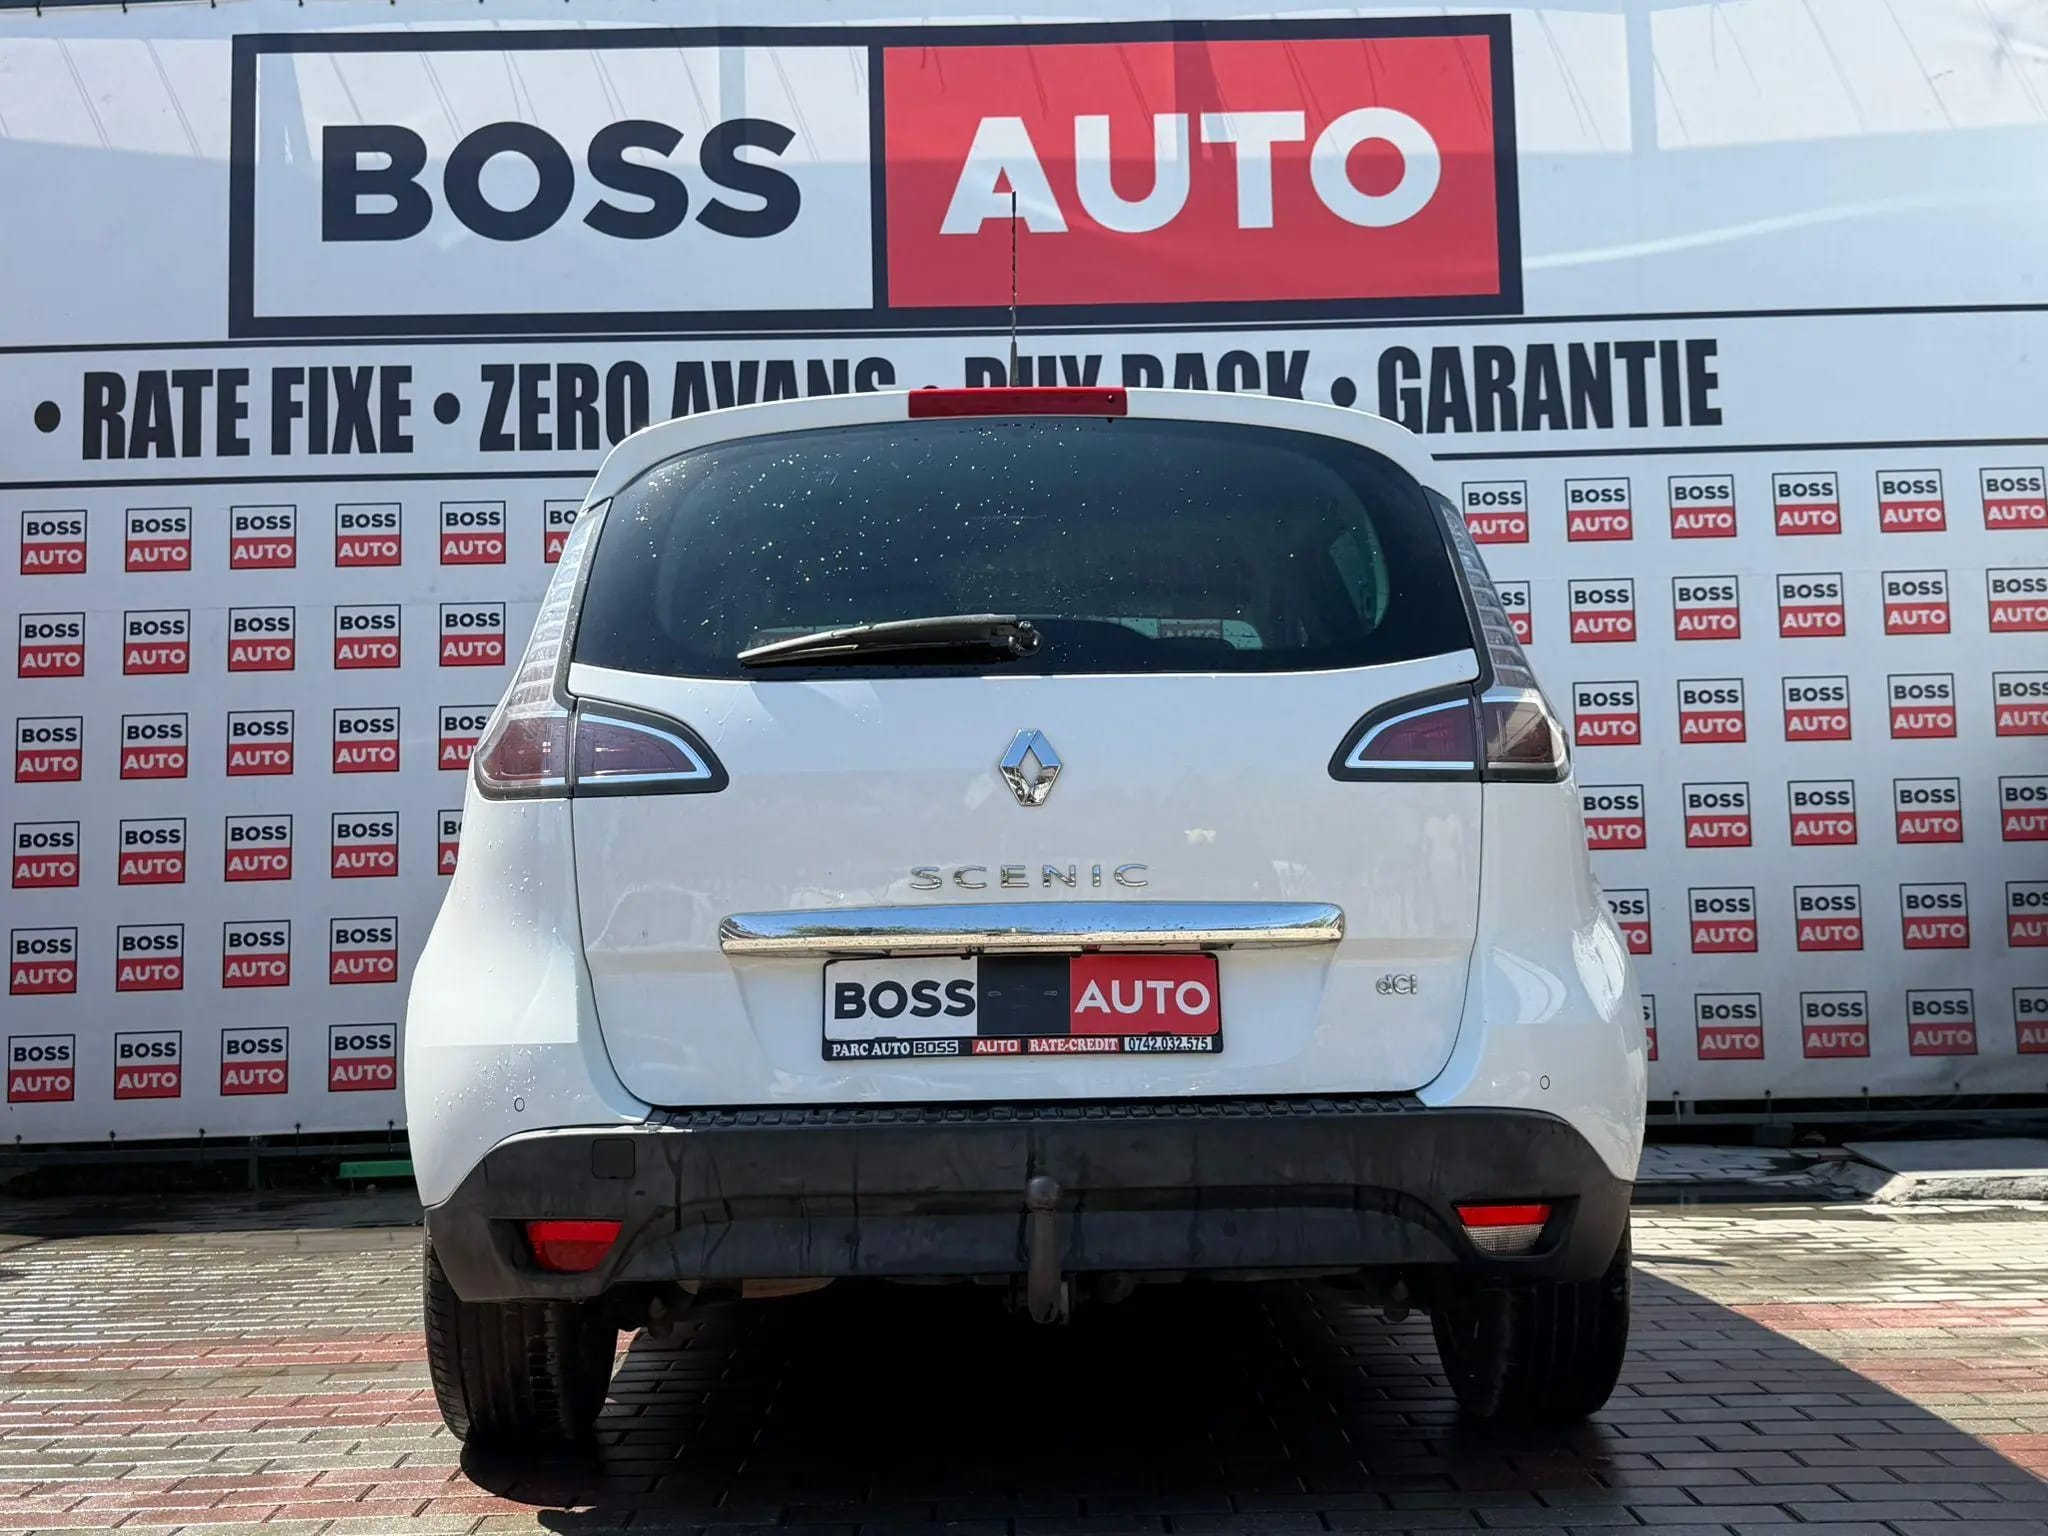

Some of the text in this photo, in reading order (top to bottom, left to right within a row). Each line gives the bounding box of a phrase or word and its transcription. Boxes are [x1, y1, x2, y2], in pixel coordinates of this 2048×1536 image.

[322, 106, 1441, 242] BOSS AUTO
[82, 368, 250, 460] RATE
[271, 365, 414, 456] FIXE
[479, 360, 649, 452] ZERO
[1377, 338, 1723, 435] GARANTIE
[1779, 482, 1833, 497] BOSS
[1883, 480, 1937, 494] BOSS
[1986, 478, 2040, 492] BOSS
[1468, 491, 1522, 506] BOSS
[1571, 488, 1625, 503] BOSS
[1675, 486, 1729, 500] BOSS
[446, 512, 500, 526] BOSS
[550, 510, 578, 524] BO
[1779, 510, 1836, 526] AUTO
[1884, 508, 1941, 523] AUTO
[1988, 506, 2045, 520] AUTO
[27, 521, 81, 536] BOSS
[132, 518, 186, 533] BOSS
[236, 516, 291, 530] BOSS
[342, 514, 396, 528] BOSS
[1468, 519, 1524, 536] AUTO
[1571, 516, 1628, 532] AUTO
[1675, 514, 1732, 528] AUTO
[129, 547, 187, 562] AUTO
[234, 544, 292, 560] AUTO
[339, 542, 397, 557] AUTO
[444, 540, 502, 555] AUTO
[24, 550, 82, 564] AUTO
[1783, 584, 1838, 598] BOSS
[1888, 581, 1943, 596] BOSS
[1993, 578, 2047, 593] BOSS
[1501, 592, 1526, 607] SS
[1575, 589, 1629, 604] BOSS
[1679, 586, 1733, 601] BOSS
[234, 618, 290, 632] BOSS
[340, 615, 395, 630] BOSS
[446, 613, 500, 627] BOSS
[1678, 615, 1736, 630] AUTO
[1783, 612, 1841, 628] AUTO
[1888, 610, 1946, 625] AUTO
[25, 624, 79, 638] BOSS
[130, 620, 184, 636] BOSS
[1574, 618, 1632, 633] AUTO
[232, 646, 291, 661] AUTO
[338, 644, 396, 659] AUTO
[444, 642, 501, 656] AUTO
[22, 652, 80, 668] AUTO
[128, 649, 186, 665] AUTO
[1579, 692, 1634, 706] BOSS
[1684, 690, 1738, 704] BOSS
[1789, 687, 1844, 702] BOSS
[1894, 684, 1949, 699] BOSS
[233, 721, 288, 736] BOSS
[340, 718, 394, 733] BOSS
[445, 716, 487, 731] BOS
[1578, 720, 1636, 736] AUTO
[1684, 718, 1742, 733] AUTO
[1789, 716, 1847, 731] AUTO
[1894, 714, 1952, 728] AUTO
[22, 728, 77, 742] BOSS
[128, 724, 182, 740] BOSS
[230, 750, 290, 766] AUTO
[336, 748, 395, 763] AUTO
[442, 745, 477, 760] AU
[19, 757, 78, 772] AUTO
[124, 754, 184, 769] AUTO
[1689, 794, 1744, 808] BOSS
[1795, 791, 1850, 806] BOSS
[1900, 789, 1955, 804] BOSS
[2005, 786, 2048, 801] BOS
[1584, 796, 1638, 810] BOSS
[338, 823, 393, 838] BOSS
[1689, 822, 1748, 838] AUTO
[1794, 820, 1853, 835] AUTO
[1900, 818, 1958, 833] AUTO
[2005, 815, 2048, 831] AUT
[19, 832, 74, 848] BOSS
[126, 829, 180, 844] BOSS
[231, 826, 286, 841] BOSS
[1585, 825, 1642, 841] AUTO
[122, 859, 181, 874] AUTO
[229, 855, 287, 871] AUTO
[336, 852, 394, 868] AUTO
[16, 862, 75, 878] AUTO
[910, 864, 1148, 890] SCENIC
[1695, 898, 1750, 912] BOSS
[1800, 896, 1856, 911] BOSS
[1906, 894, 1962, 909] BOSS
[336, 928, 392, 944] BOSS
[1695, 928, 1754, 943] AUTO
[1800, 926, 1859, 941] AUTO
[1906, 924, 1965, 939] AUTO
[17, 939, 72, 954] BOSS
[123, 935, 178, 951] BOSS
[230, 932, 284, 947] BOSS
[120, 965, 179, 981] AUTO
[226, 961, 286, 978] AUTO
[334, 958, 394, 974] AUTO
[14, 968, 73, 984] AUTO
[835, 979, 1210, 1019] BOSS AUTO
[2020, 998, 2048, 1013] BO
[1702, 1004, 1756, 1019] BOSS
[1807, 1002, 1863, 1017] BOSS
[1912, 1000, 1968, 1015] BOSS
[335, 1034, 391, 1050] BOSS
[1701, 1034, 1760, 1049] AUTO
[1808, 1032, 1866, 1047] AUTO
[1913, 1030, 1972, 1045] AUTO
[121, 1042, 176, 1058] BOSS
[227, 1038, 283, 1054] BOSS
[832, 1036, 1209, 1057] PARC AUTO BOSS AUTO RATE-CREDIT 0742.032.575
[14, 1046, 69, 1062] BOSS
[118, 1072, 177, 1088] AUTO
[225, 1068, 284, 1085] AUTO
[332, 1064, 392, 1081] AUTO
[12, 1076, 70, 1092] AUTO
